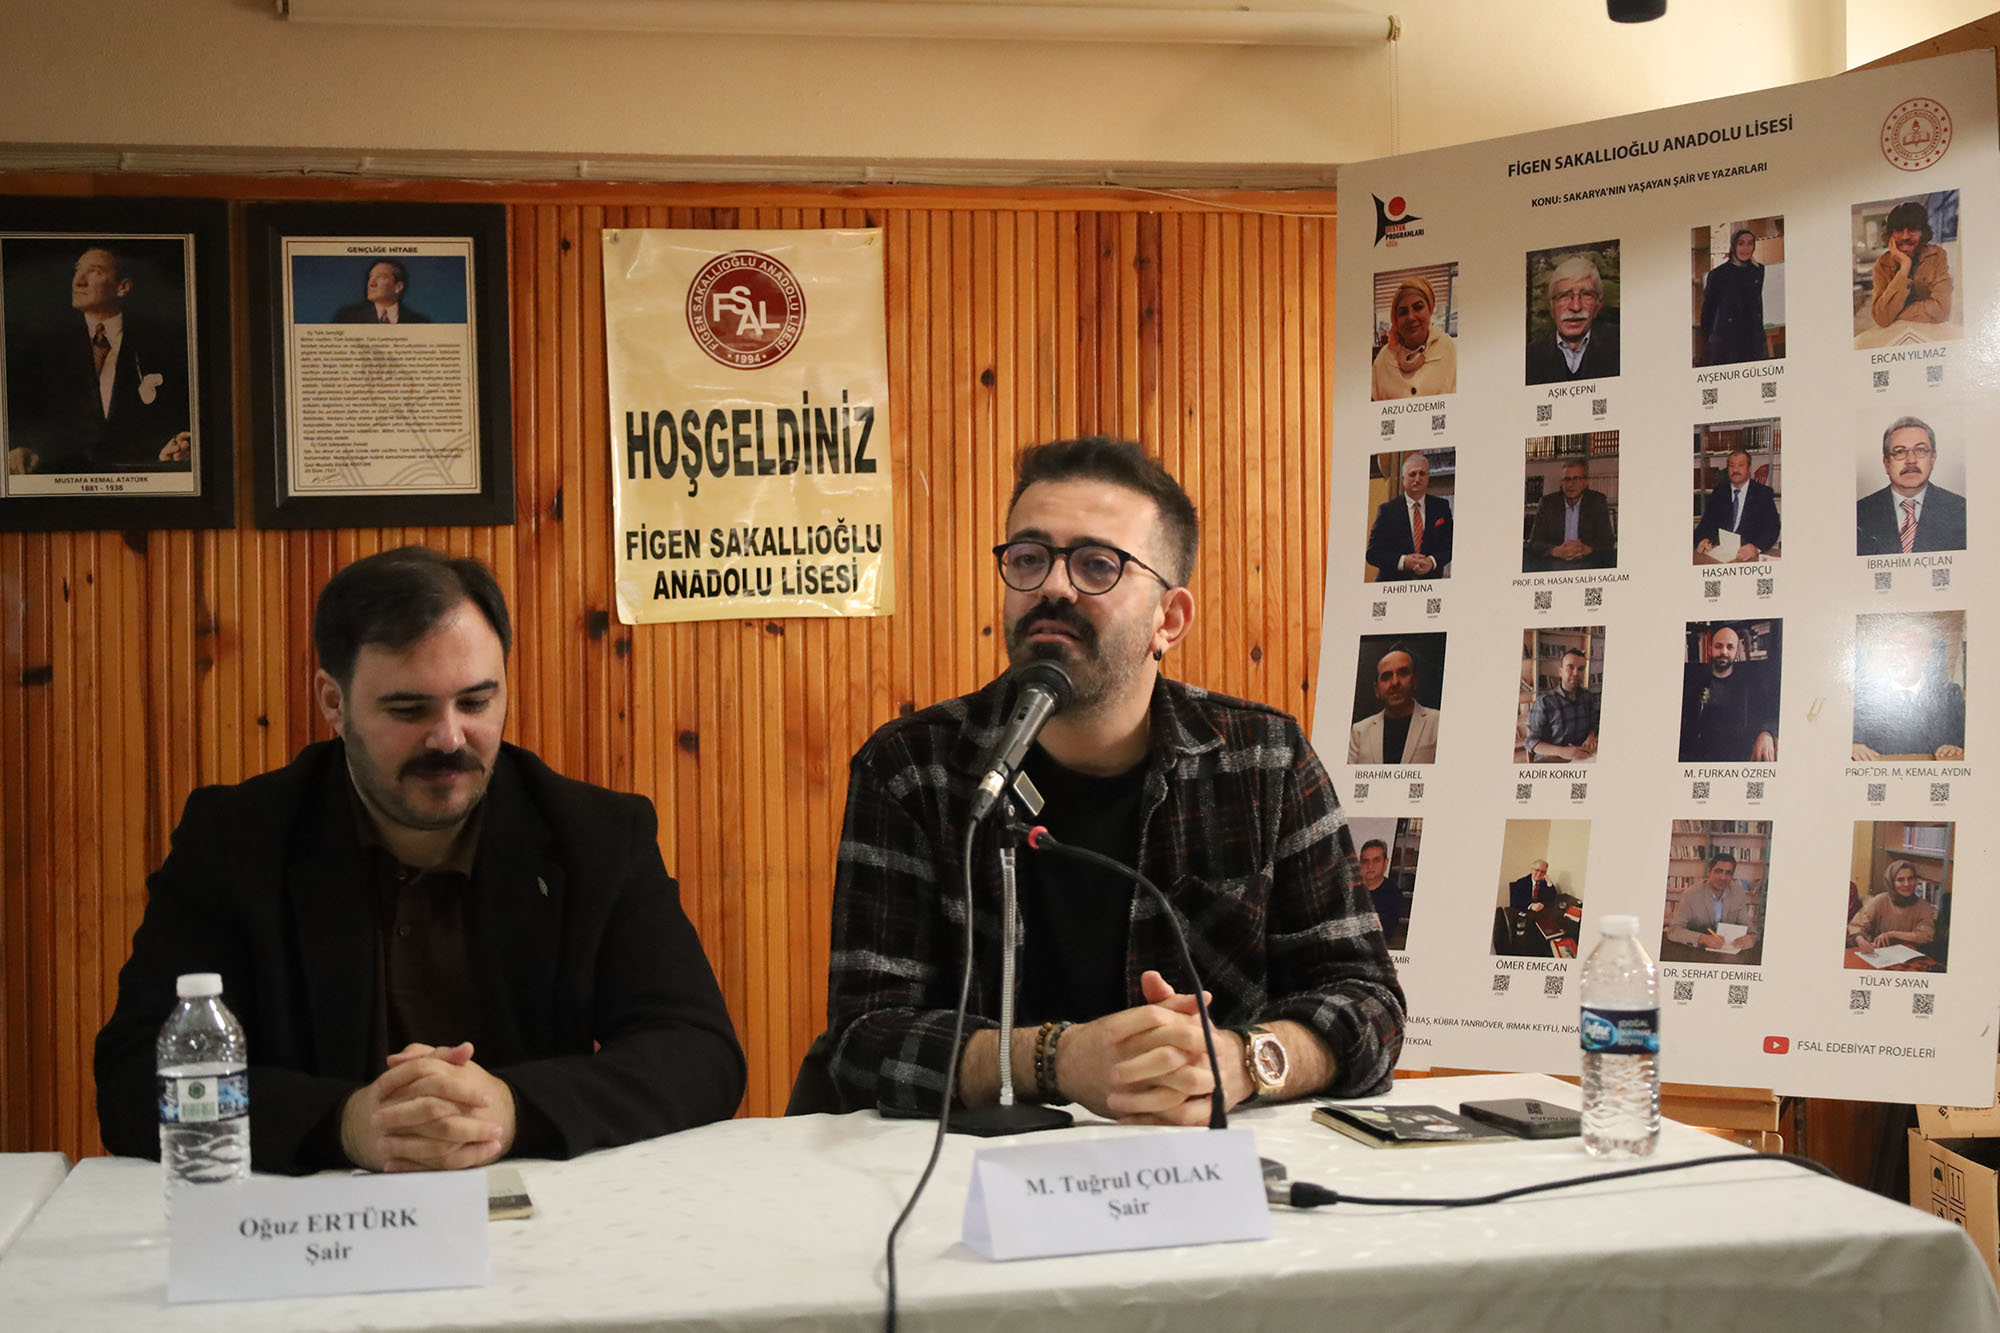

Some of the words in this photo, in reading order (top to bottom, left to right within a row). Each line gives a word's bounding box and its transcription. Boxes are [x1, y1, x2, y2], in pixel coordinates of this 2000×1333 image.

[1508, 158, 1551, 177] FİGEN
[1555, 140, 1659, 170] SAKALLIOĞLU
[1663, 126, 1741, 152] ANADOLU
[1746, 114, 1793, 138] LİSESİ
[1532, 195, 1561, 207] KONU:
[1627, 177, 1671, 193] YAŞAYAN
[1673, 173, 1696, 188] ŞAİR
[1697, 171, 1710, 181] VE
[1711, 162, 1767, 179] YAZARLARI
[759, 261, 800, 311] ANADOLU
[735, 354, 761, 364] 1994
[1871, 352, 1906, 365] ERCAN
[1907, 347, 1946, 360] YILMAZ
[1697, 370, 1740, 384] AYŞENUR
[1742, 365, 1784, 379] GÜLSÜM
[1548, 387, 1568, 399] AŞIK
[1569, 383, 1596, 397] ÇEPNİ
[1381, 405, 1405, 415] ARZU
[1406, 400, 1446, 414] ÖZDEMİR
[626, 389, 878, 498] HOŞGELDİNİZ
[54, 477, 88, 485] MUSTAFA
[626, 523, 701, 560] FİGEN
[710, 518, 882, 559] SAKALLIOĞLU
[1867, 558, 1911, 569] İBRAHİM
[1914, 556, 1952, 569] AÇILAN
[653, 566, 772, 600] ANADOLU
[782, 556, 858, 595] LİSESİ
[1702, 567, 1736, 578] HASAN
[1738, 565, 1772, 578] TOPÇU
[1512, 579, 1532, 587] PROF.
[1534, 578, 1546, 586] DR.
[1547, 577, 1574, 585] HASAN
[1575, 575, 1596, 584] SALİH
[1598, 573, 1629, 583] SAĞLAM
[1383, 585, 1407, 594] FAHRİ
[1409, 584, 1433, 593] TUNA
[1355, 770, 1392, 779] İBRAHİM
[1393, 769, 1422, 779] GÜREL
[1519, 769, 1548, 779] KADİR
[1549, 770, 1588, 779] KORKUT
[1684, 769, 1696, 778] M.
[1698, 769, 1739, 778] FURKAN
[1741, 768, 1776, 778] ÖZREN
[1496, 960, 1524, 970] ÖMER
[1526, 961, 1567, 972] EMECAN
[1663, 968, 1679, 978] DR.
[1681, 969, 1719, 981] SERHAT
[1720, 970, 1764, 982] DEMİREL
[1859, 975, 1892, 987] TÜLAY
[1894, 978, 1929, 989] SAYAN
[1797, 1040, 1823, 1052] FSAL
[1826, 1042, 1877, 1055] EDEBİYAT
[1878, 1045, 1936, 1058] PROJELERİ
[1026, 1178, 1053, 1195] M.
[1060, 1171, 1131, 1196] Tuğrul
[1137, 1164, 1223, 1190] ÇOLAK
[1108, 1198, 1150, 1221] Şair
[239, 1216, 299, 1240] Oğuz
[307, 1207, 418, 1234] ERTÜRK
[305, 1242, 352, 1265] Şair
